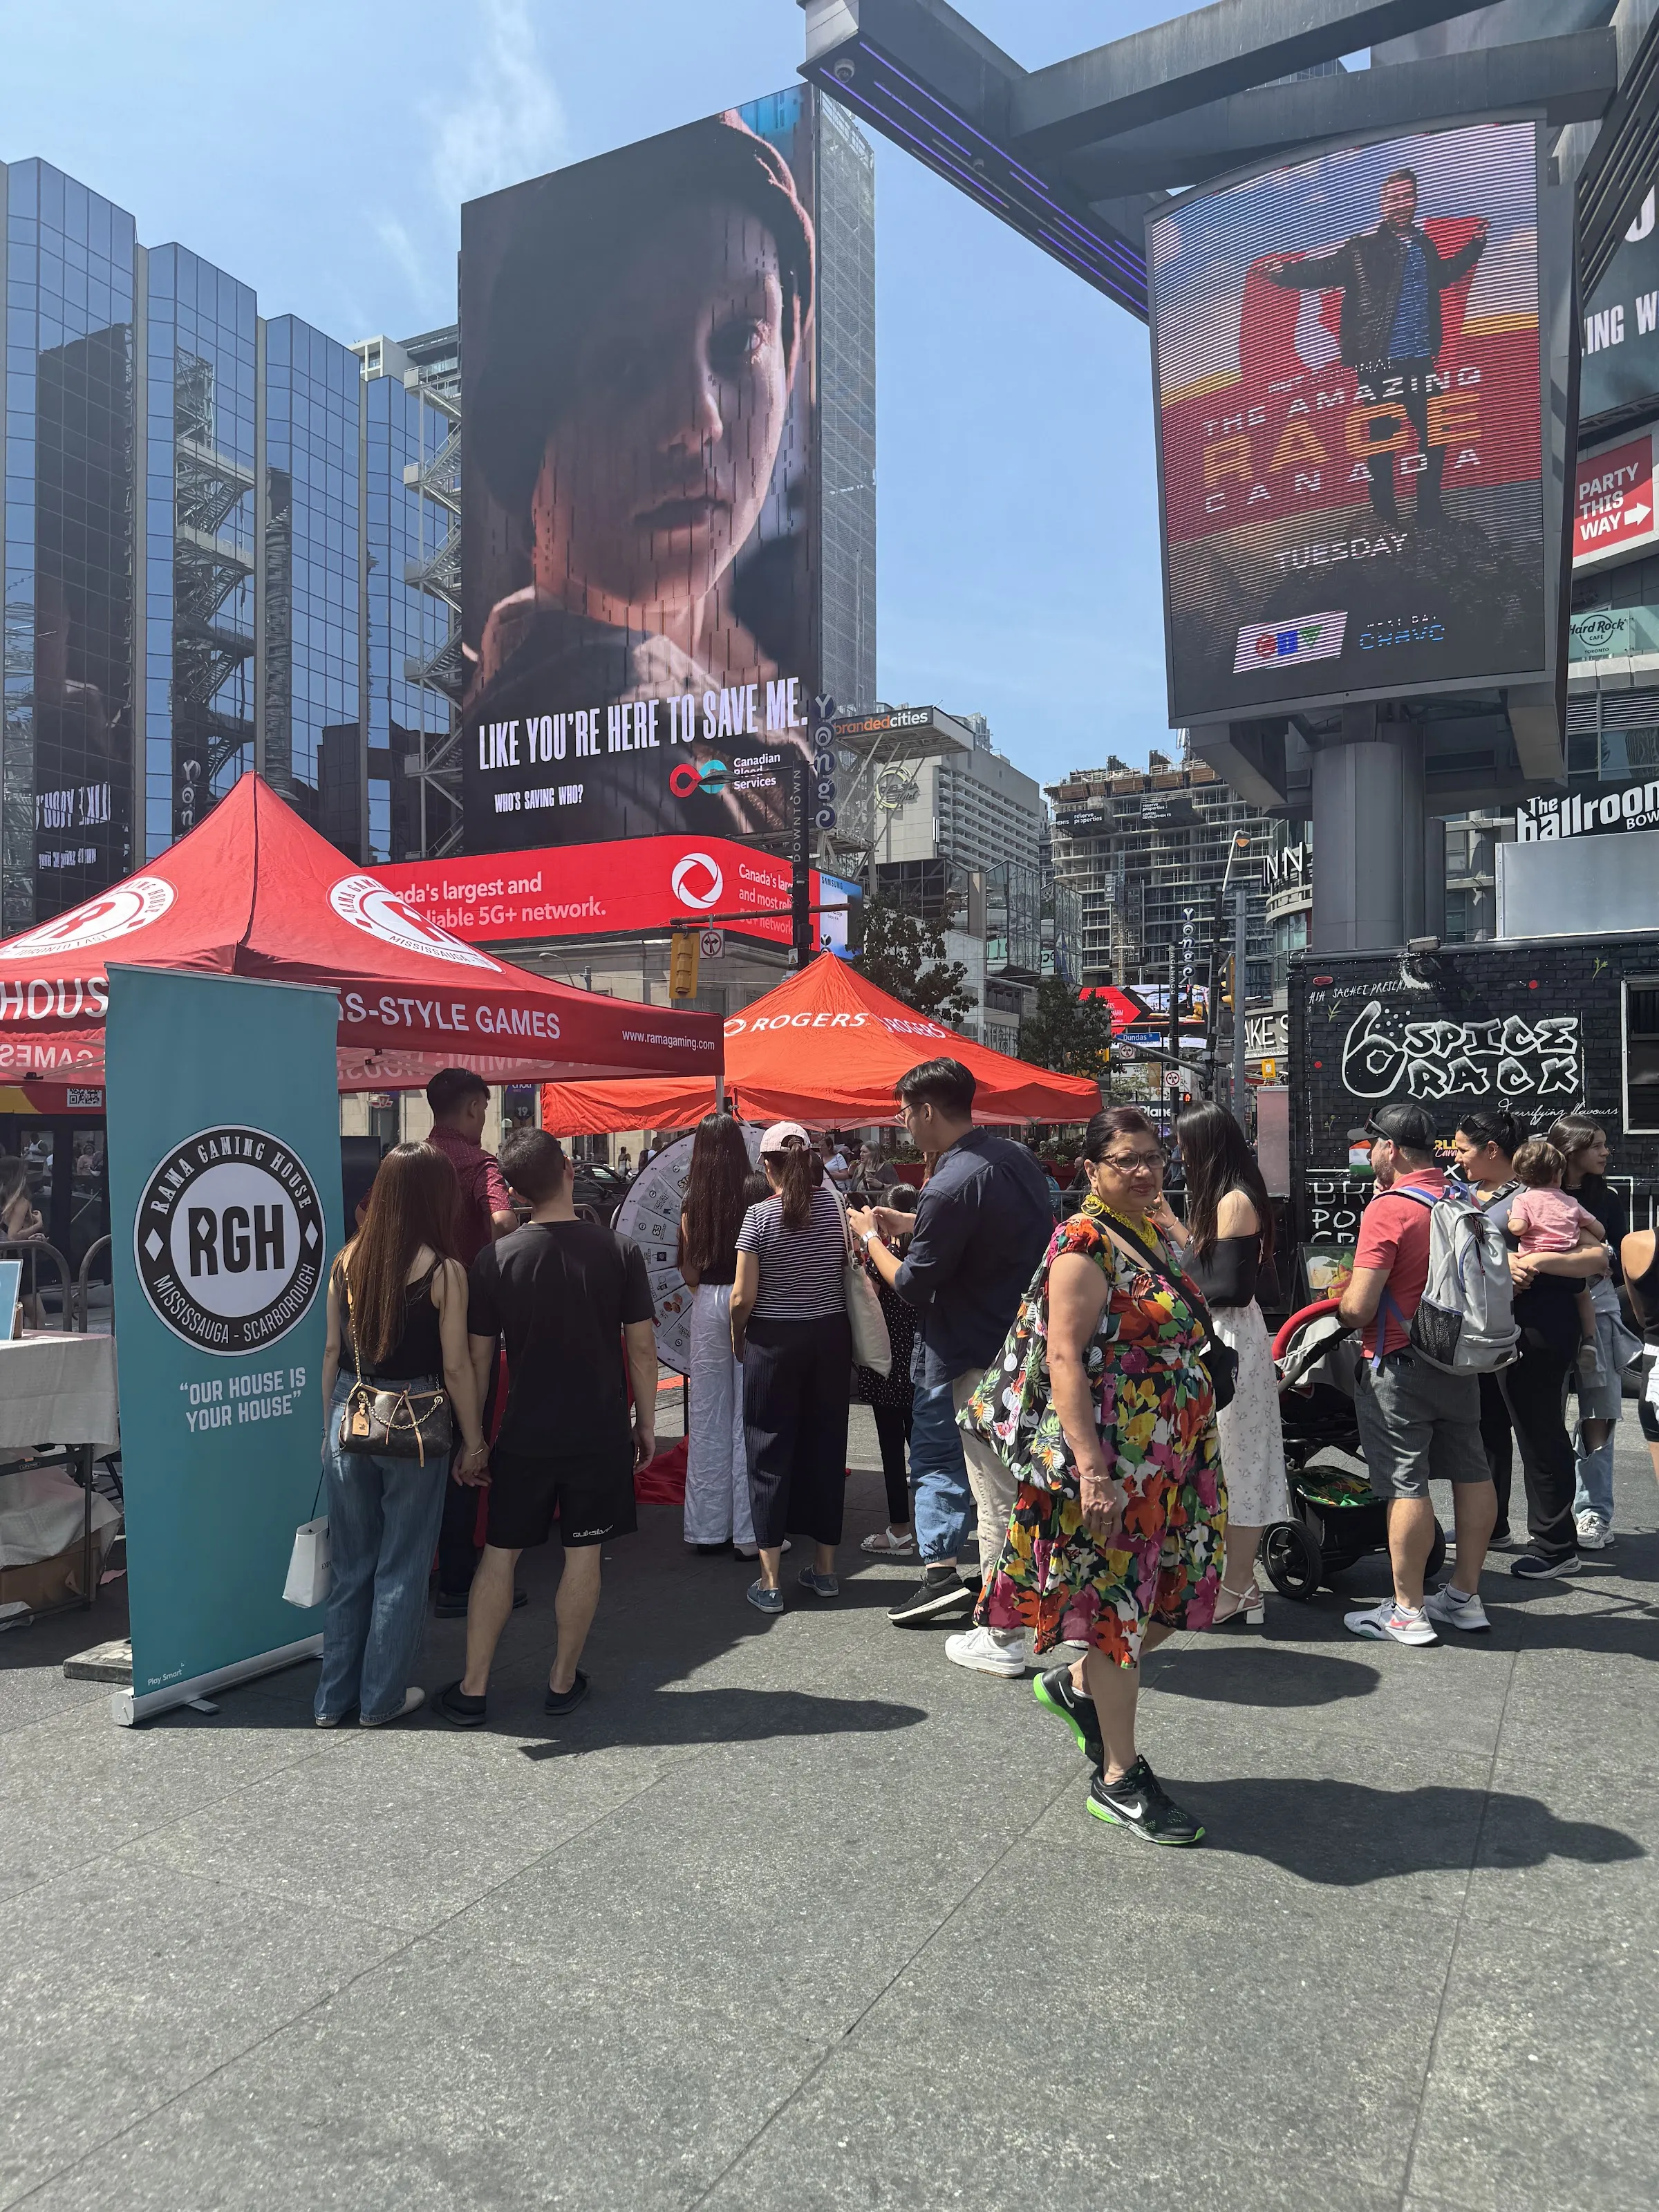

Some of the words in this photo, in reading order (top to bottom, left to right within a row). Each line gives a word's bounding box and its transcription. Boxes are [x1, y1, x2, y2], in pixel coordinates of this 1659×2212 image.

[1582, 305, 1624, 357] ING
[1635, 290, 1659, 335] W
[1201, 406, 1266, 436] THE
[1286, 366, 1481, 418] AMAZING
[1202, 391, 1483, 489] RACE
[1206, 449, 1481, 514] CANADA
[1579, 462, 1639, 501] PARTY
[1580, 490, 1624, 520] THIS
[1580, 511, 1622, 541] WAY
[1273, 533, 1407, 570] TUESDAY
[1570, 621, 1596, 635] Hard
[1597, 618, 1624, 633] Rock
[478, 720, 521, 770] LIKE
[526, 707, 601, 763] YOU'RE
[608, 697, 661, 755] HERE
[666, 693, 695, 744] TO
[702, 683, 759, 741] SAVE
[766, 676, 809, 731] ME.
[835, 711, 928, 735] brandedcities
[733, 753, 780, 768] Canadian
[814, 693, 836, 830] Yonge
[733, 776, 777, 790] Services
[494, 791, 521, 813] WHO'S
[524, 787, 555, 809] SAVING
[558, 784, 583, 806] WHO?
[1526, 796, 1558, 817] The
[1074, 816, 1103, 825] properties
[443, 878, 504, 905] largest
[507, 870, 542, 894] and
[738, 863, 777, 888] Canada's
[821, 876, 843, 890] SAMSUNG
[478, 904, 518, 926] 5G+
[521, 895, 606, 921] network.
[739, 888, 759, 903] and
[757, 894, 778, 909] most
[778, 899, 794, 910] reli
[389, 935, 470, 963] MISSISSAUGA
[1182, 908, 1196, 978] Yonge
[1332, 984, 1369, 999] SACHET
[1369, 980, 1409, 997] PRESEN
[475, 1006, 561, 1040] GAMES
[750, 1012, 869, 1033] ROGERS
[883, 1017, 946, 1038] ROGERS
[622, 1030, 715, 1051] www.ramagaming.com
[1342, 1000, 1408, 1098] 6
[1403, 1015, 1578, 1059] SPICE
[1407, 1056, 1579, 1100] RACK
[1570, 1102, 1619, 1116] flavours
[151, 1158, 195, 1215] RAMA
[197, 1136, 265, 1163] GAMING
[270, 1151, 312, 1210] HOUSE
[188, 1204, 285, 1277] RGH
[153, 1274, 229, 1344] MISSISSAUGA
[243, 1263, 316, 1342] SCARBOROUGH
[180, 1380, 223, 1405] "OUR
[229, 1370, 284, 1399] HOUSE
[290, 1367, 306, 1389] IS
[185, 1405, 232, 1433] YOUR
[238, 1390, 301, 1423] HOUSE"
[147, 1677, 162, 1686] Play
[162, 1668, 182, 1681] Smart
